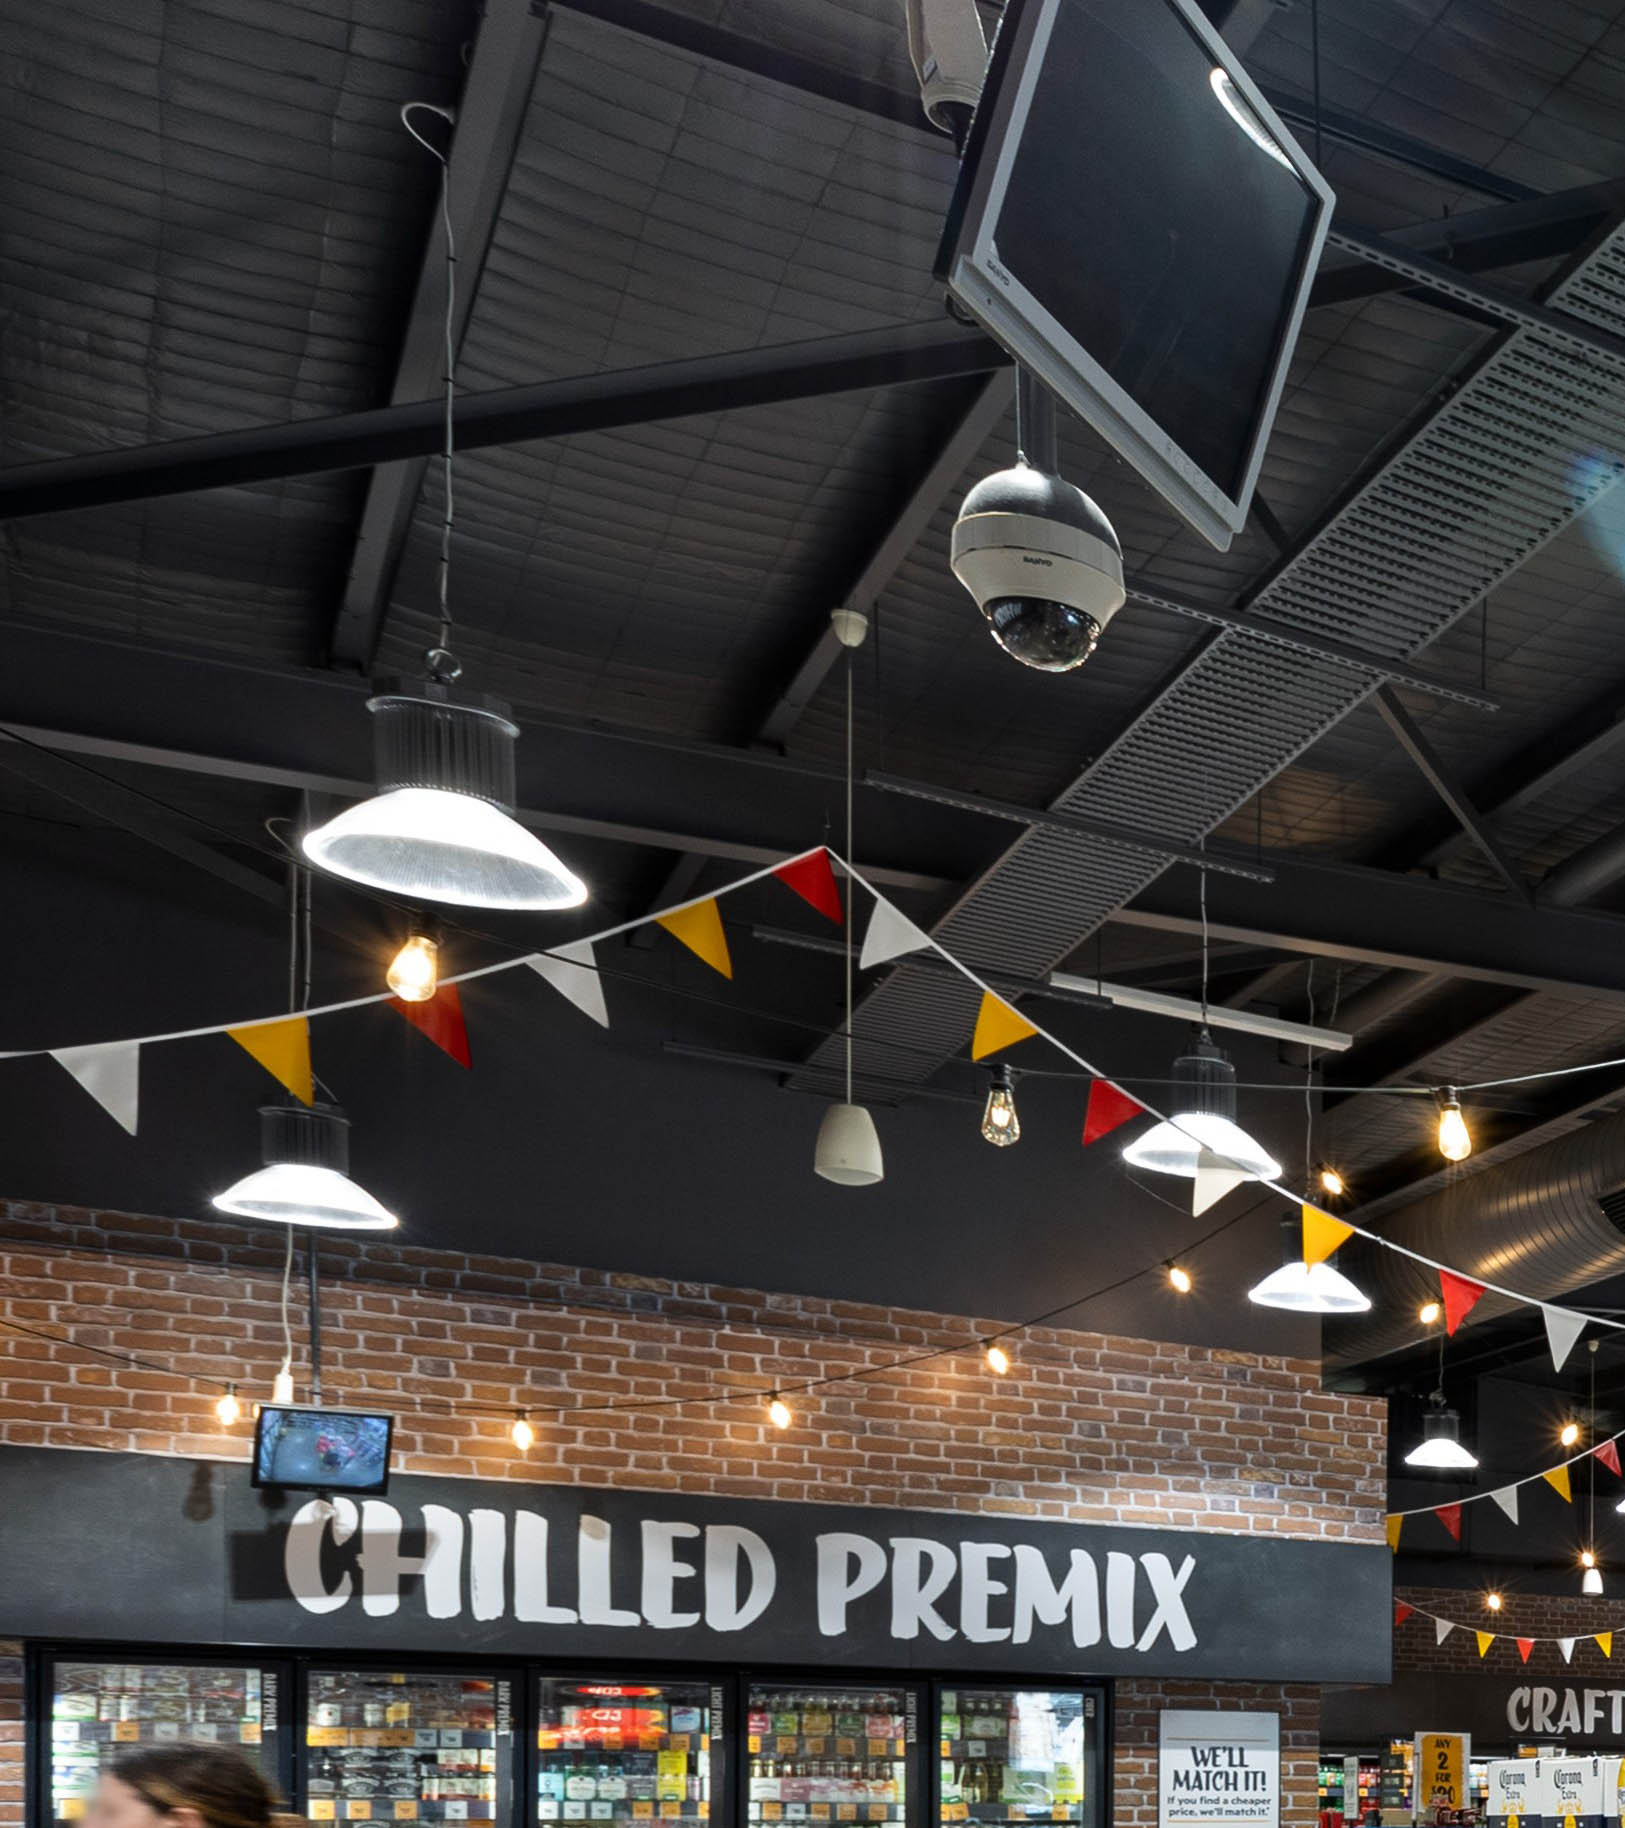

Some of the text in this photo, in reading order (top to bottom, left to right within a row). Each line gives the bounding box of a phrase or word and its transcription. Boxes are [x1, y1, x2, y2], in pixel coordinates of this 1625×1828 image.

[285, 1496, 1198, 1652] CHILLED PREMIX
[1435, 1739, 1451, 1748] ANY
[1190, 1746, 1249, 1767] WE'LL
[1437, 1753, 1448, 1769] 2
[1173, 1770, 1266, 1791] MATCH IT!
[1436, 1772, 1449, 1782] FOR
[1500, 1769, 1525, 1788] Corona
[1200, 1796, 1220, 1804] find
[1231, 1797, 1271, 1805] cheaper
[1506, 1788, 1521, 1800] Extra
[1169, 1808, 1197, 1817] price,
[1225, 1808, 1256, 1816] match
